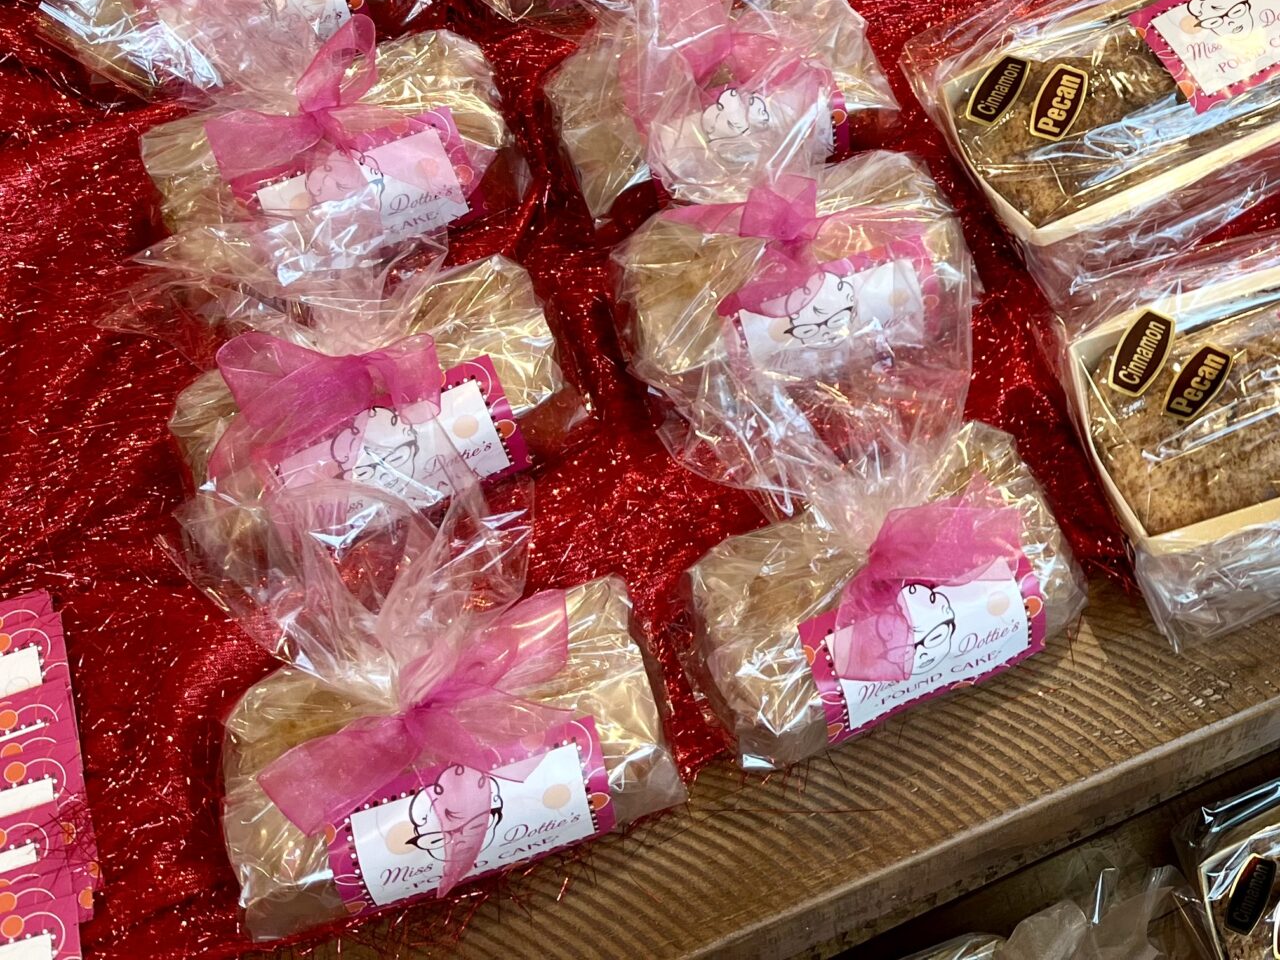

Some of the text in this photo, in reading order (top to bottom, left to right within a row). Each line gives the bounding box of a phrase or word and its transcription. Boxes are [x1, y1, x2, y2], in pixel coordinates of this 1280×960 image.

[977, 62, 1022, 116] Cinnamon
[1037, 74, 1082, 134] Pecan
[1118, 319, 1166, 385] Cinnamon
[1169, 353, 1227, 414] Pecan
[953, 618, 1021, 659] Dottie's
[880, 650, 996, 706] POUND CAKE
[379, 811, 582, 887] Miss Dottie's
[497, 836, 554, 861] CAKE
[1232, 862, 1270, 925] Cinnamon
